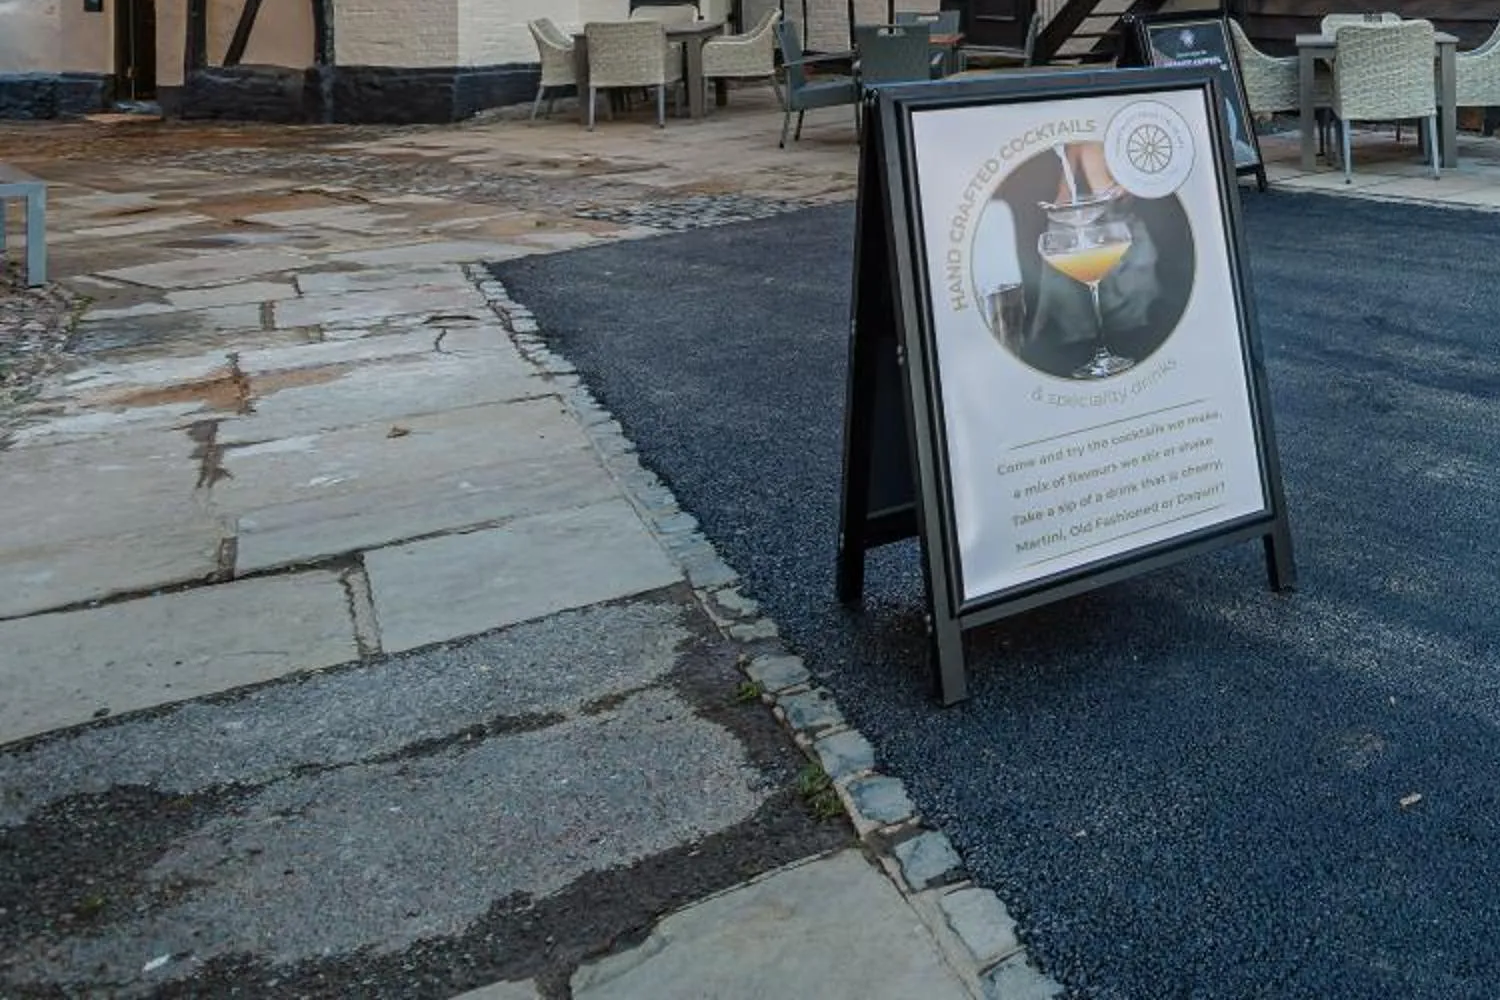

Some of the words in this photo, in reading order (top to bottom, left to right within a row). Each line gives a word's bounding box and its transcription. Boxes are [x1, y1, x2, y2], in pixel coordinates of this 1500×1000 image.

[1000, 119, 1097, 160] COCKTAILS
[950, 159, 1000, 244] CRAFTED
[947, 248, 969, 312] HAND
[1131, 359, 1178, 395] drinks
[997, 458, 1035, 475] Come
[1039, 449, 1063, 465] and
[1067, 443, 1085, 457] try
[1087, 437, 1109, 451] the
[1111, 423, 1165, 445] cocktails
[1167, 420, 1185, 431] we
[1025, 480, 1049, 496] mix
[1052, 475, 1065, 488] of
[1067, 463, 1119, 483] flavours
[1120, 457, 1139, 469] we
[1142, 449, 1160, 462] stir
[1163, 446, 1175, 457] or
[1179, 437, 1214, 453] shake
[1013, 510, 1043, 527] Take
[1058, 500, 1077, 513] sip
[1080, 493, 1092, 506] of
[1106, 483, 1138, 499] drink
[1141, 473, 1166, 488] that
[1016, 528, 1066, 552] Martini,
[1069, 521, 1093, 537] Old
[1096, 502, 1159, 528] Fashioned
